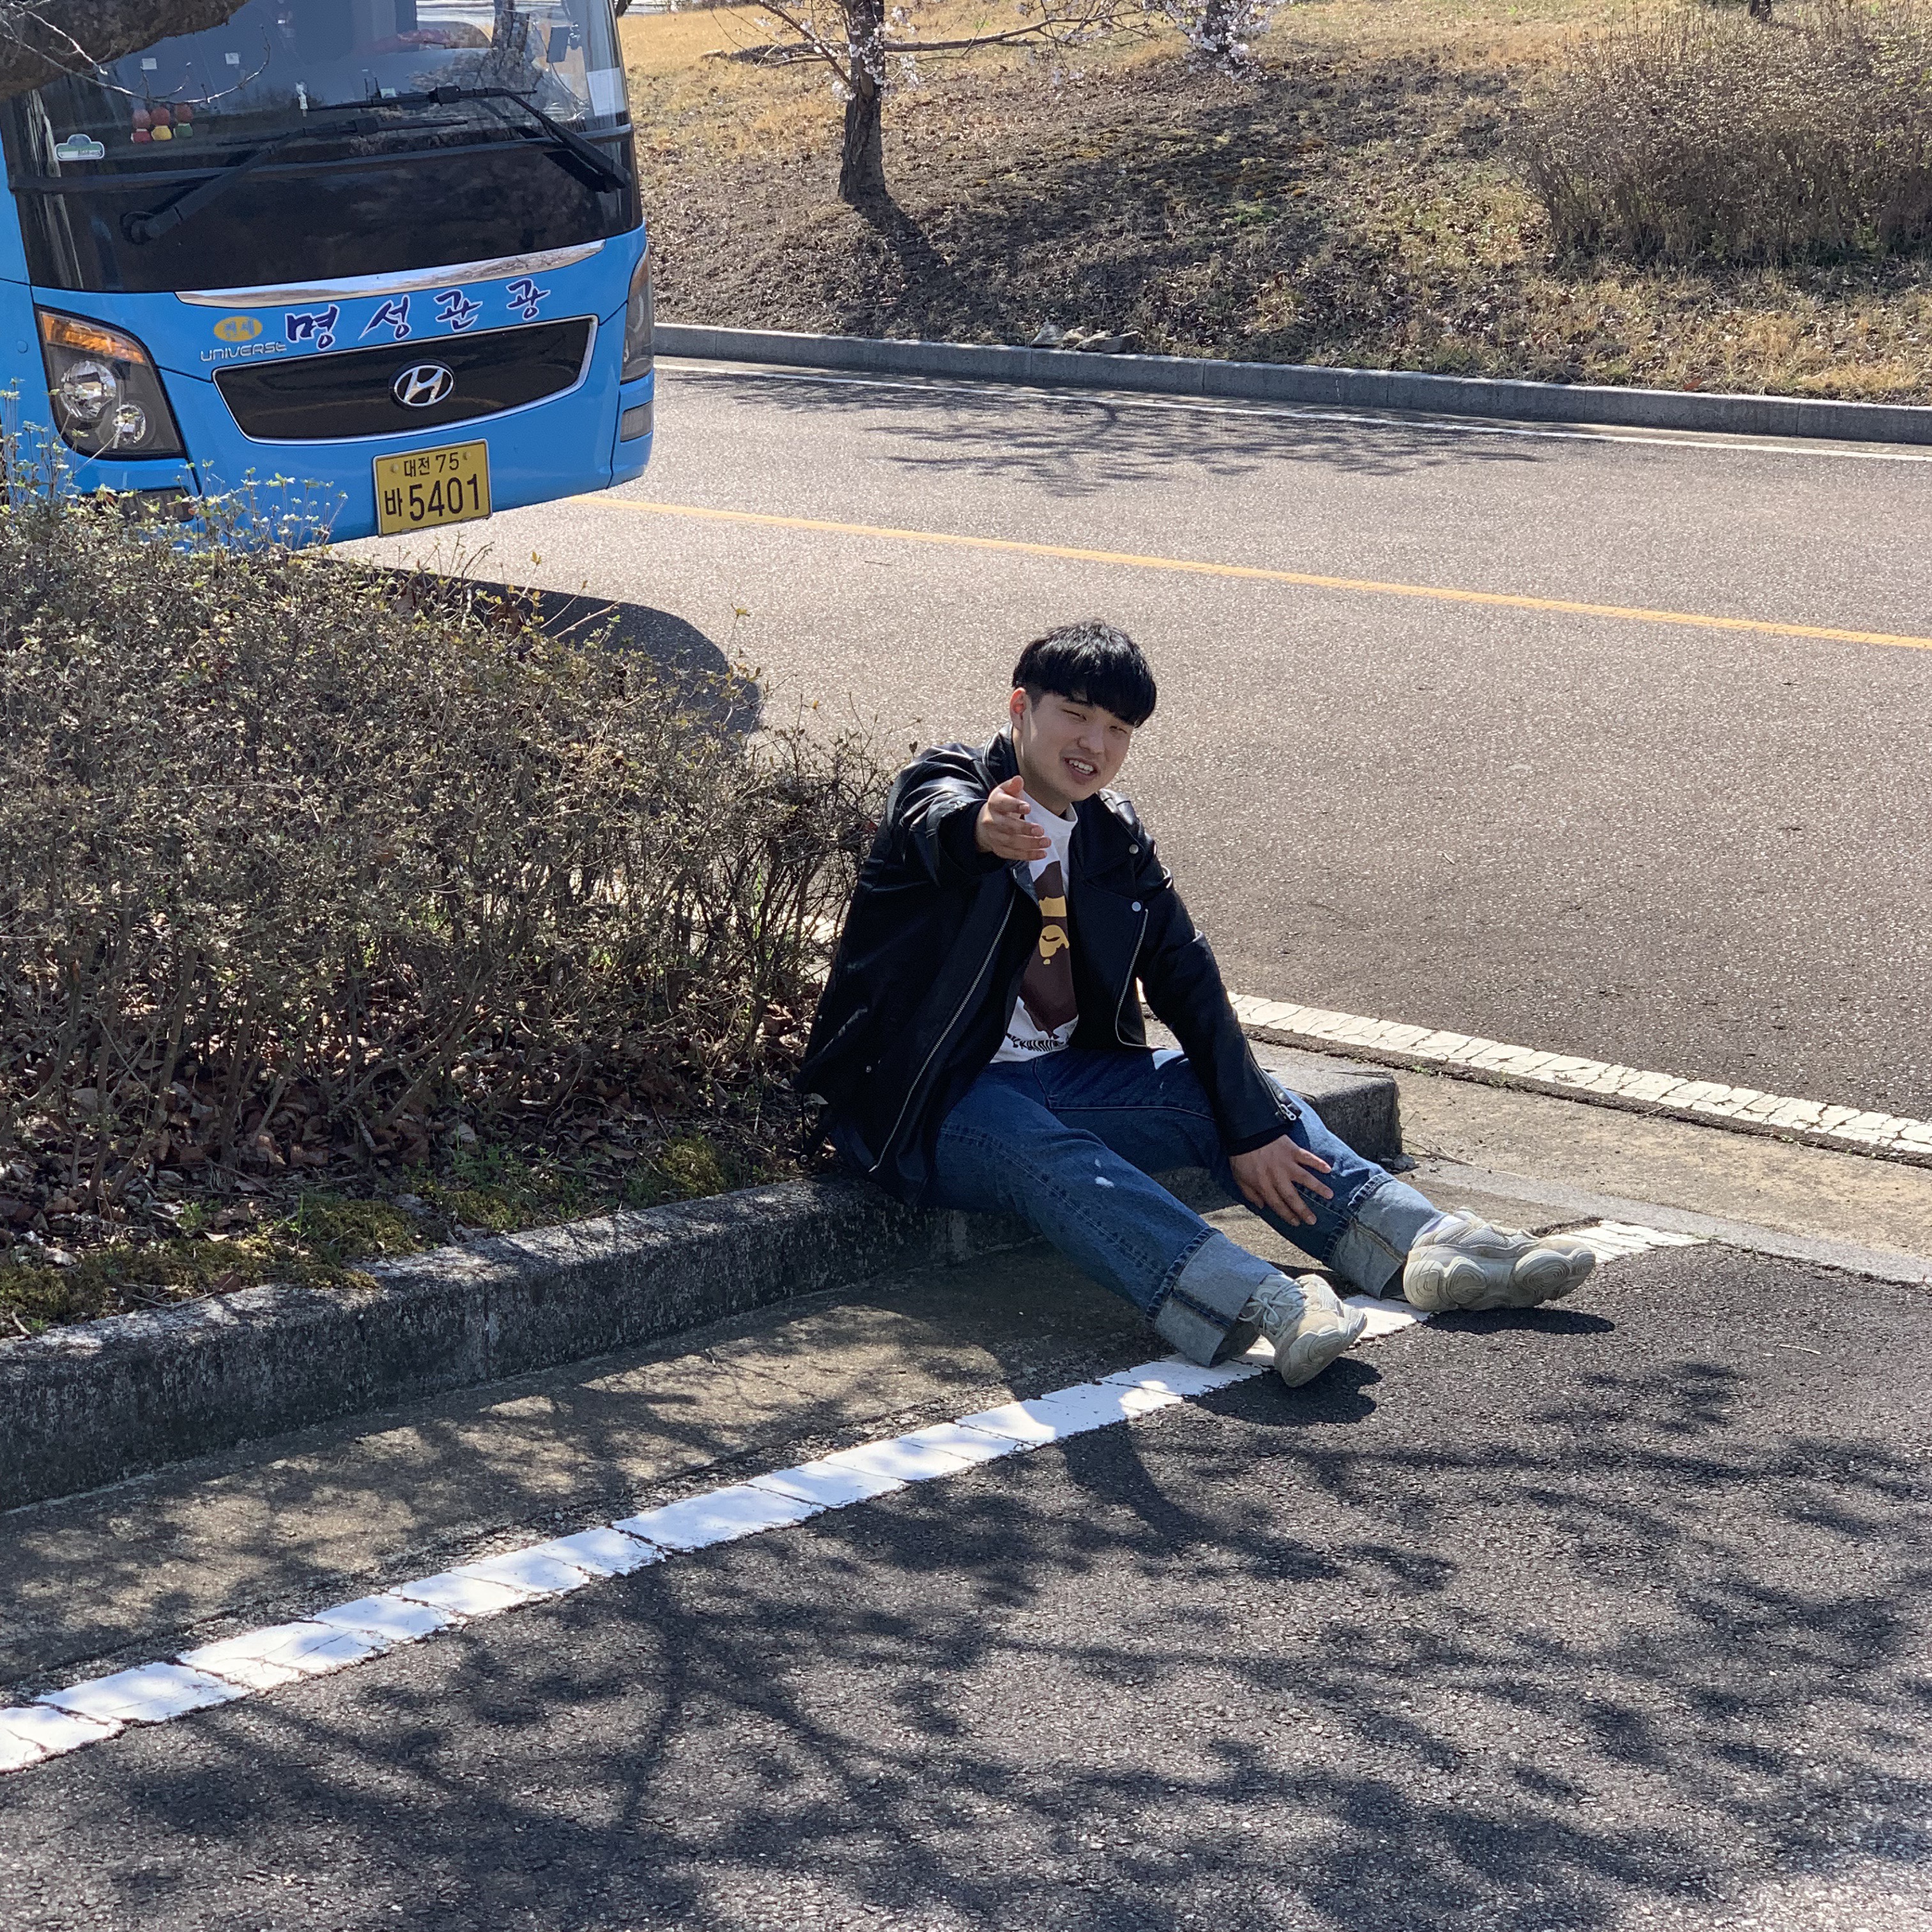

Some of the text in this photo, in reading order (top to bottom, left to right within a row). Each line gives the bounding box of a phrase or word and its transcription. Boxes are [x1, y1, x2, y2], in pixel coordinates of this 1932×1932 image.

[201, 342, 287, 362] UNIVERSE
[404, 452, 459, 477] 대전 75
